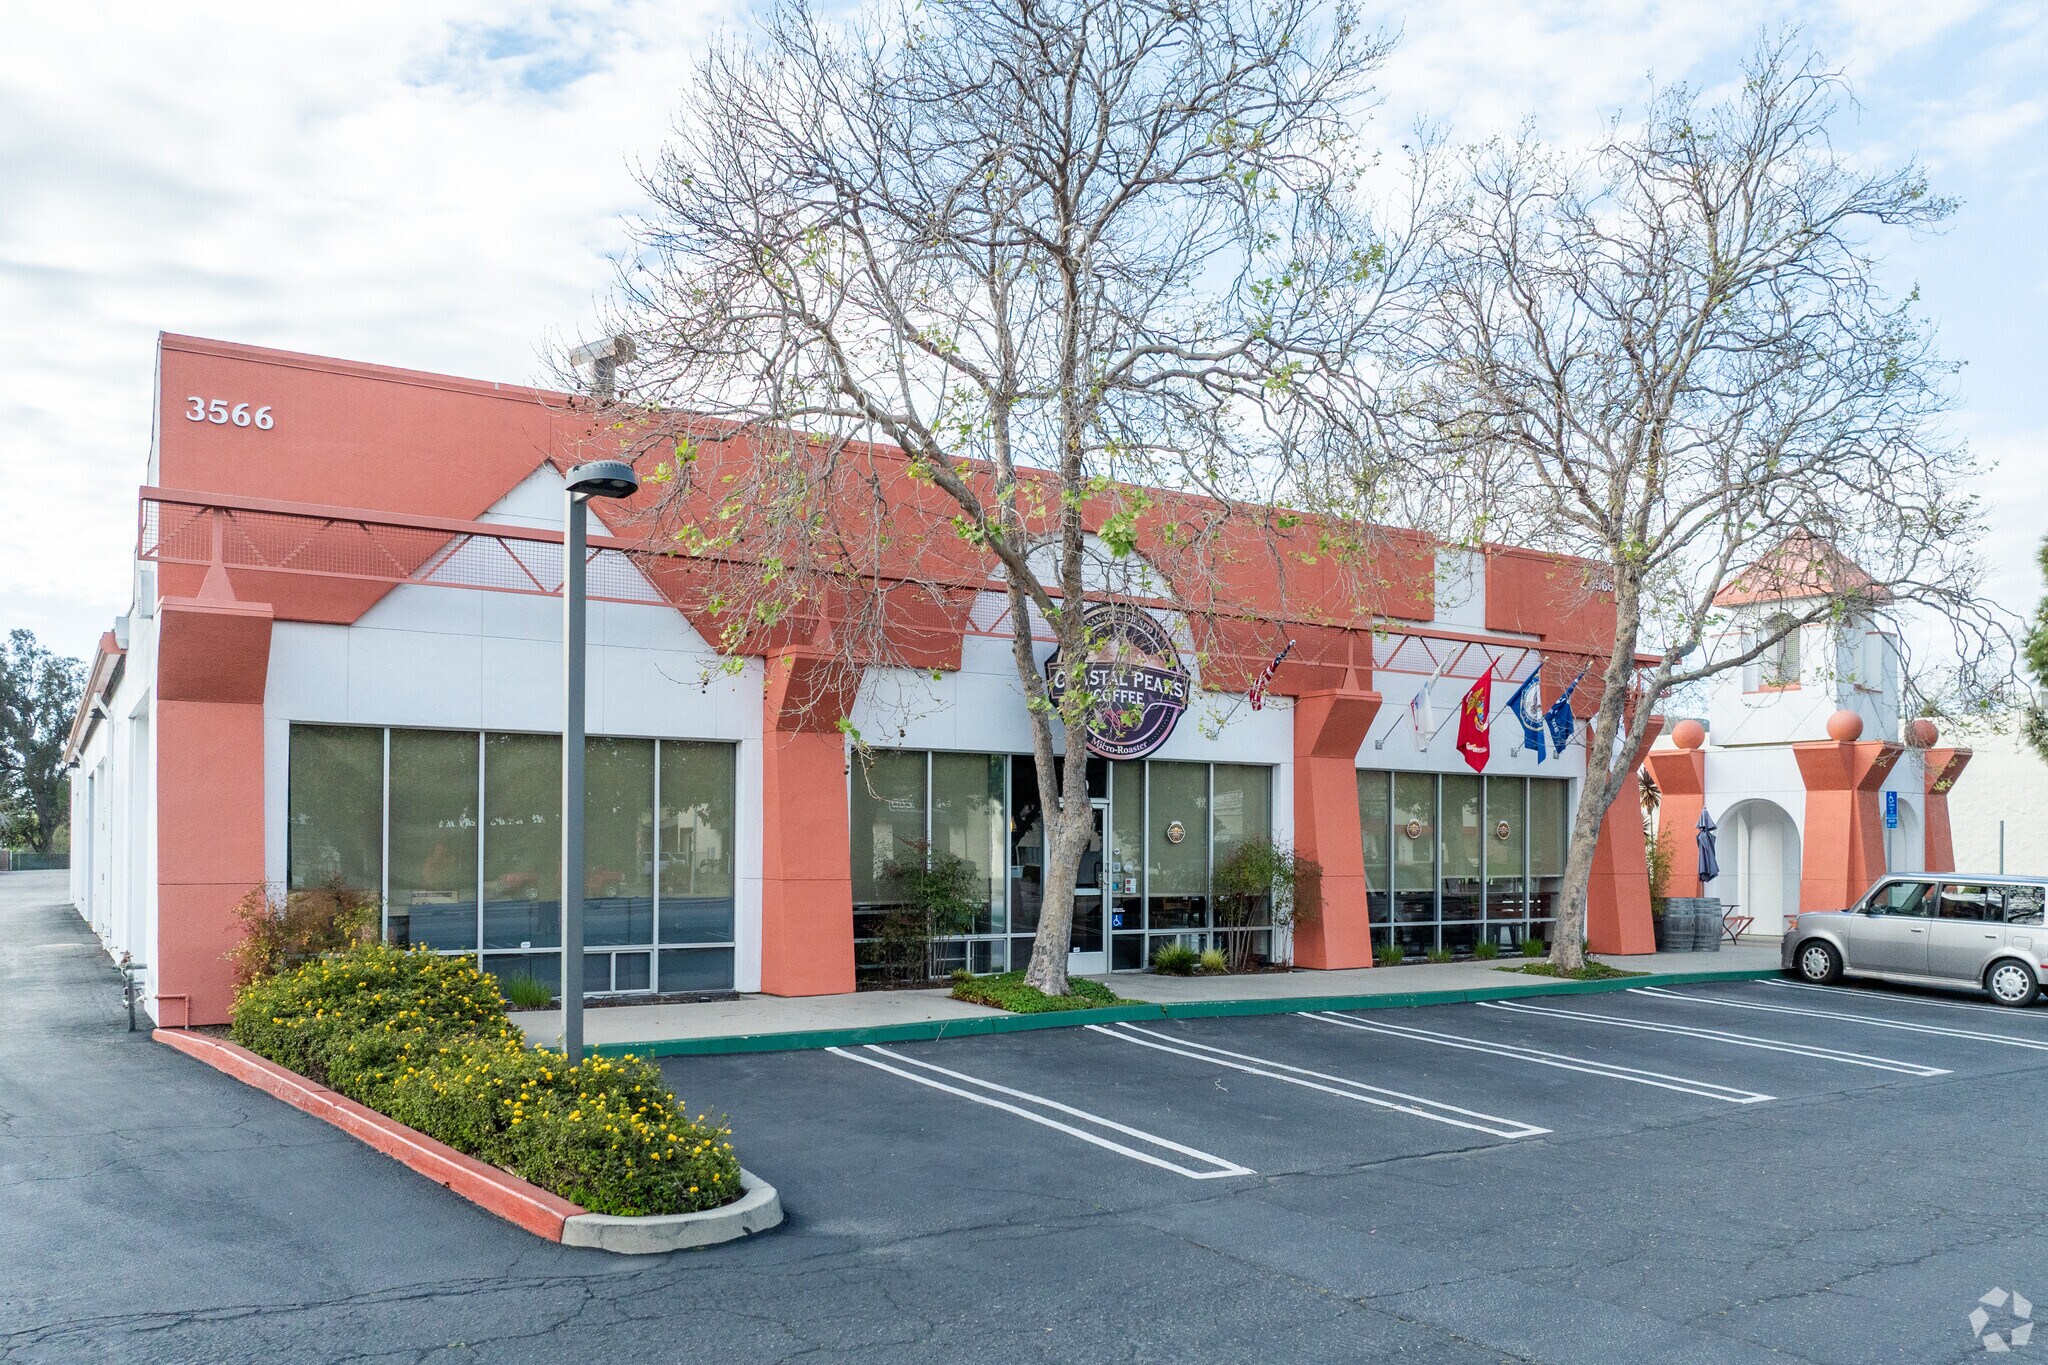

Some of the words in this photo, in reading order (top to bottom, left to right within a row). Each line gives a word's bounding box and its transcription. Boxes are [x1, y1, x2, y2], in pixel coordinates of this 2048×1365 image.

[186, 396, 274, 430] 3566
[1086, 615, 1104, 626] SAN
[1091, 736, 1147, 755] Micro-Roaster
